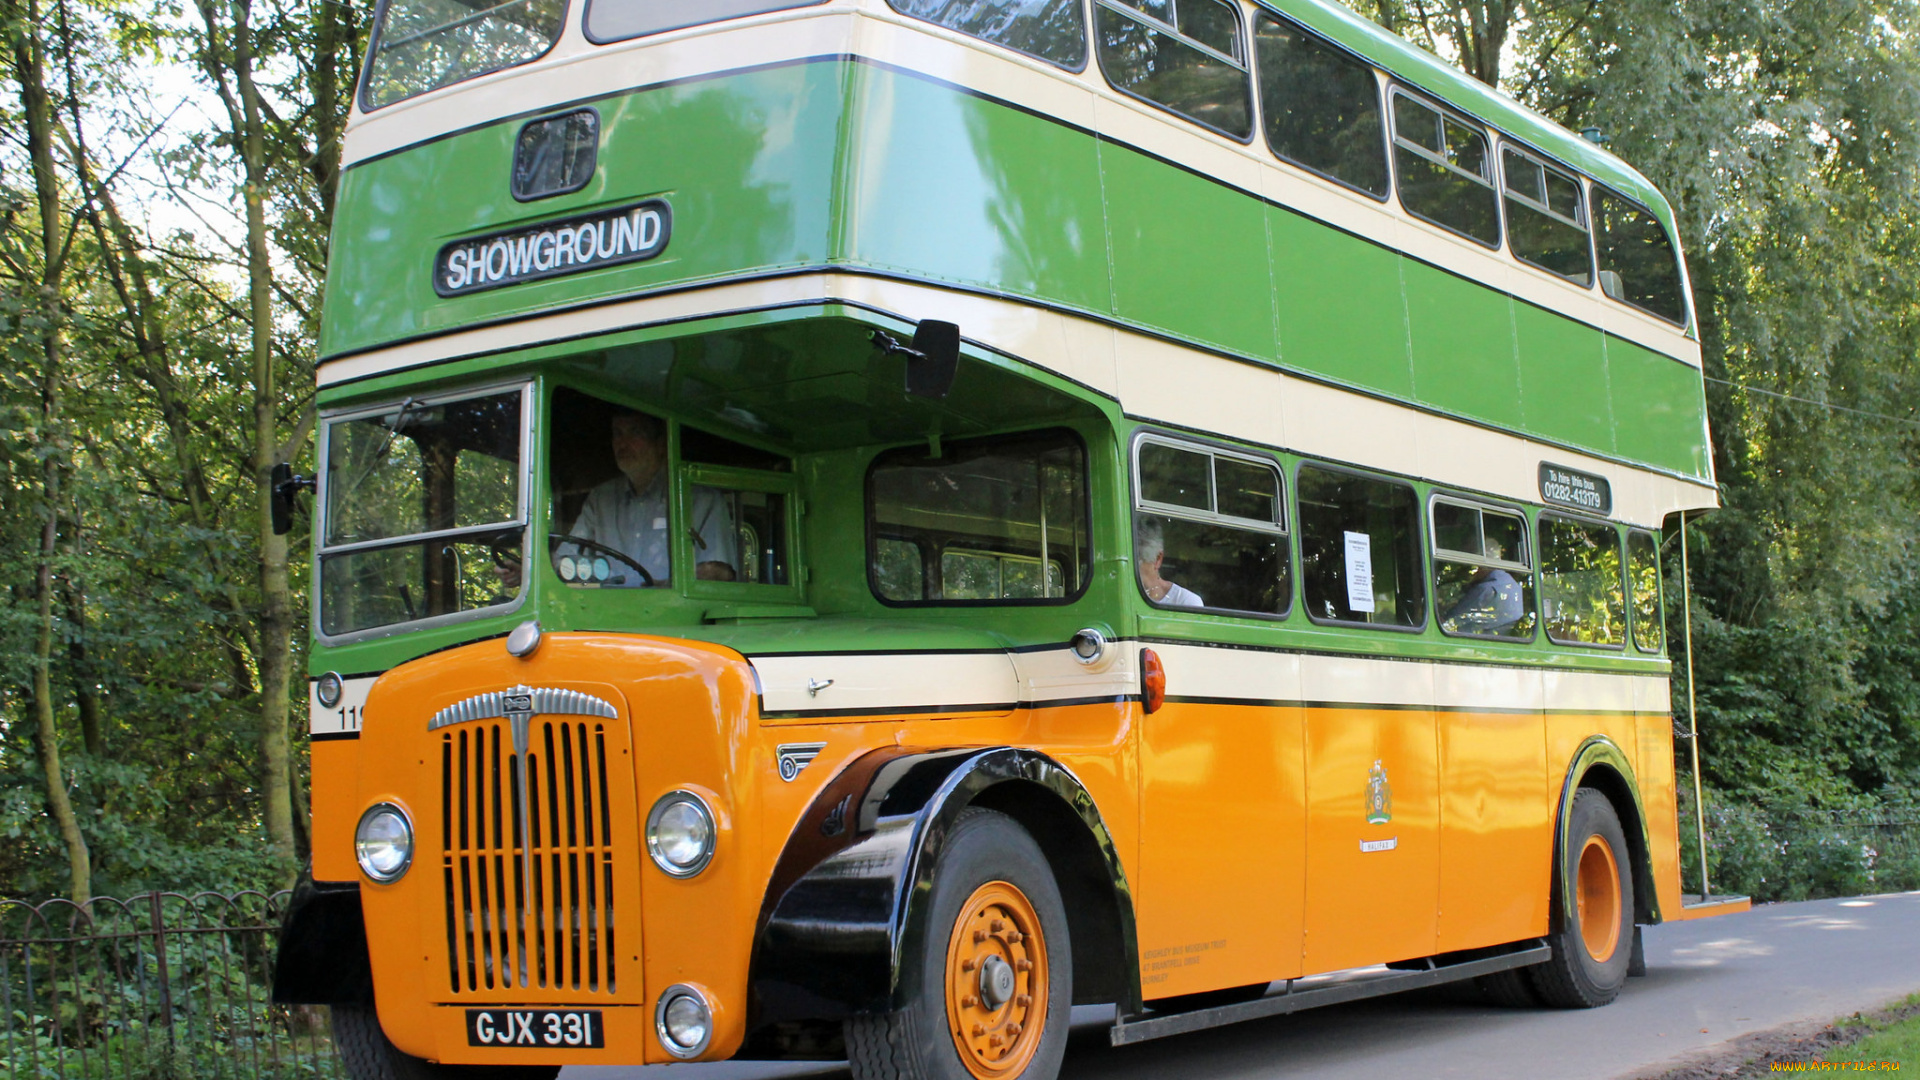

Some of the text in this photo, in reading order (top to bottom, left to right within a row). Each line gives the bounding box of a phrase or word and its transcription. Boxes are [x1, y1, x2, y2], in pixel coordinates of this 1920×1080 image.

[446, 210, 662, 289] SHOWGROUND
[1549, 469, 1595, 491] To hire this bus
[1544, 481, 1600, 508] 01282-413179
[1367, 841, 1389, 851] HALIFAX
[1143, 939, 1226, 960] KEIGHLEY BUS MUSEUM TRUST
[1184, 955, 1200, 966] DRIVE
[1142, 972, 1169, 985] BURNLEY
[476, 1012, 592, 1046] GJX 331
